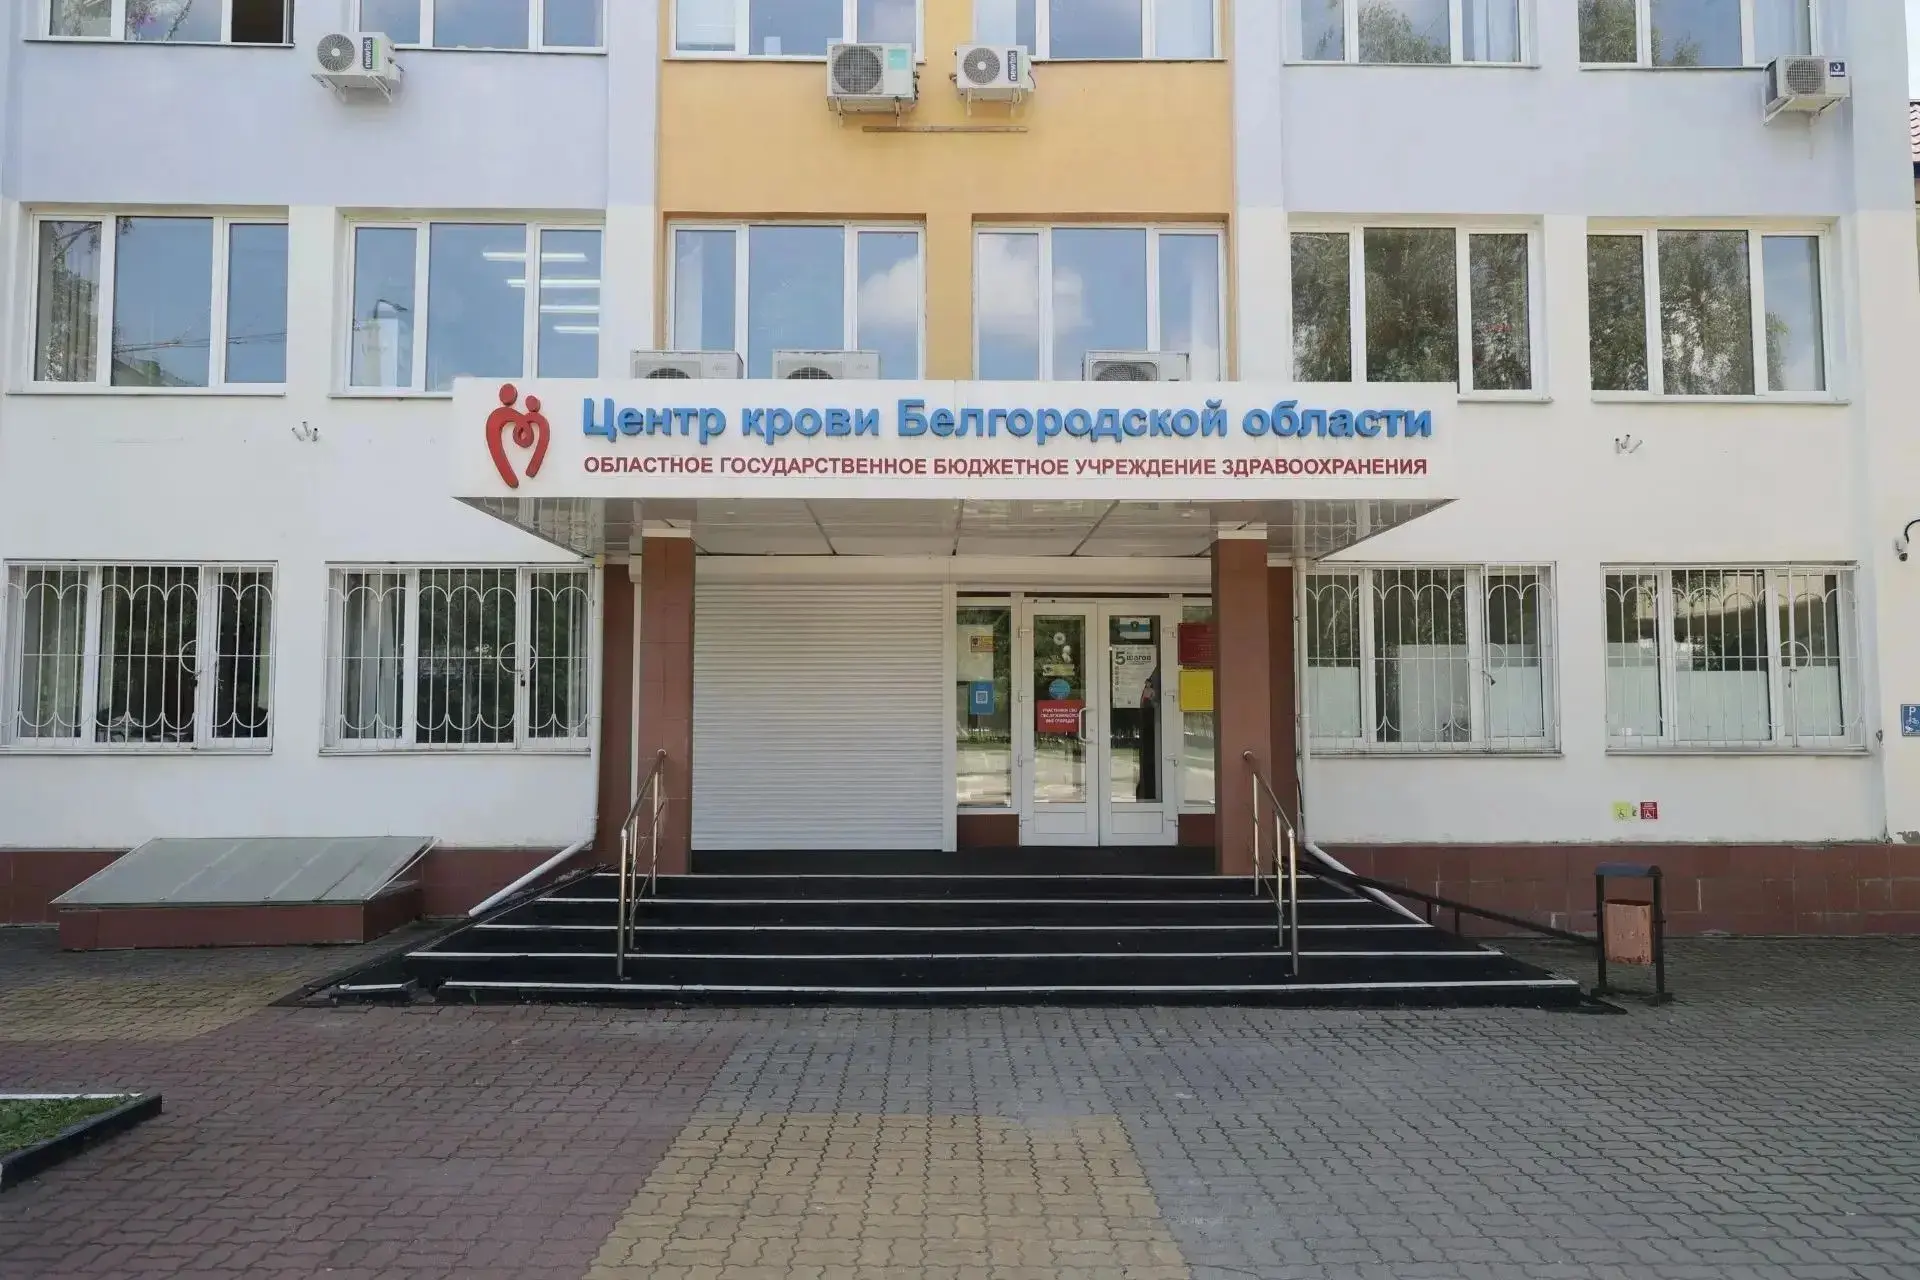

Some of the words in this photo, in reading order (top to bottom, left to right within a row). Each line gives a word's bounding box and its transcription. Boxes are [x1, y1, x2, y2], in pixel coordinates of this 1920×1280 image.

[582, 398, 726, 444] Центр
[741, 407, 880, 444] крови
[897, 399, 1228, 445] Белгородской
[1242, 400, 1432, 438] области
[584, 456, 713, 474] ОБЛАСТНОЕ
[720, 457, 926, 477] ГОСУДАРСТВЕННОЕ
[934, 458, 1068, 477] БЮДЖЕТНОЕ
[1075, 459, 1216, 476] УЧРЕЖДЕНИЕ
[1222, 459, 1428, 477] ЗДРАВООХРАНЕНИЯ
[1114, 651, 1125, 665] 5
[1909, 706, 1916, 715] P
